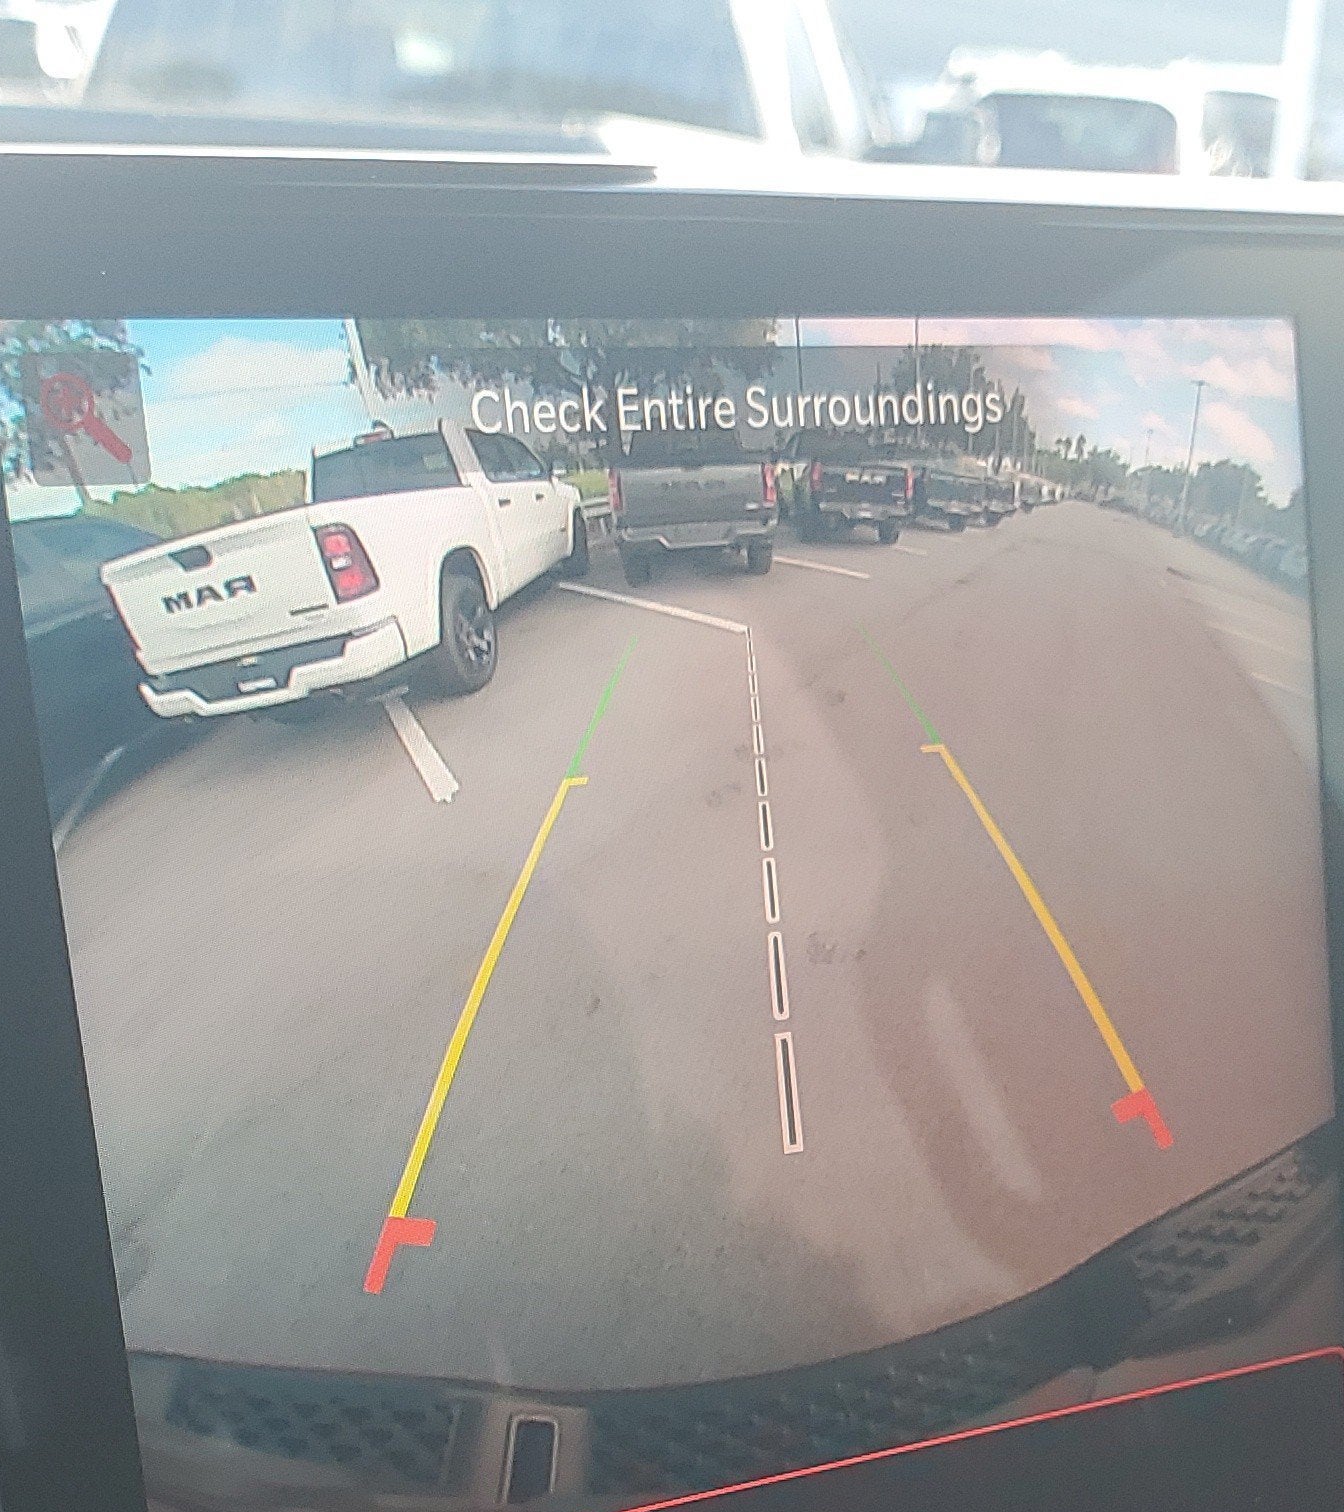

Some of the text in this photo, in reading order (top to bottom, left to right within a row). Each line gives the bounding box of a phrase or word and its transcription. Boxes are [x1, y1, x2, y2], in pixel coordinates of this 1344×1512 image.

[471, 384, 1003, 435] Check Entire Surroundings
